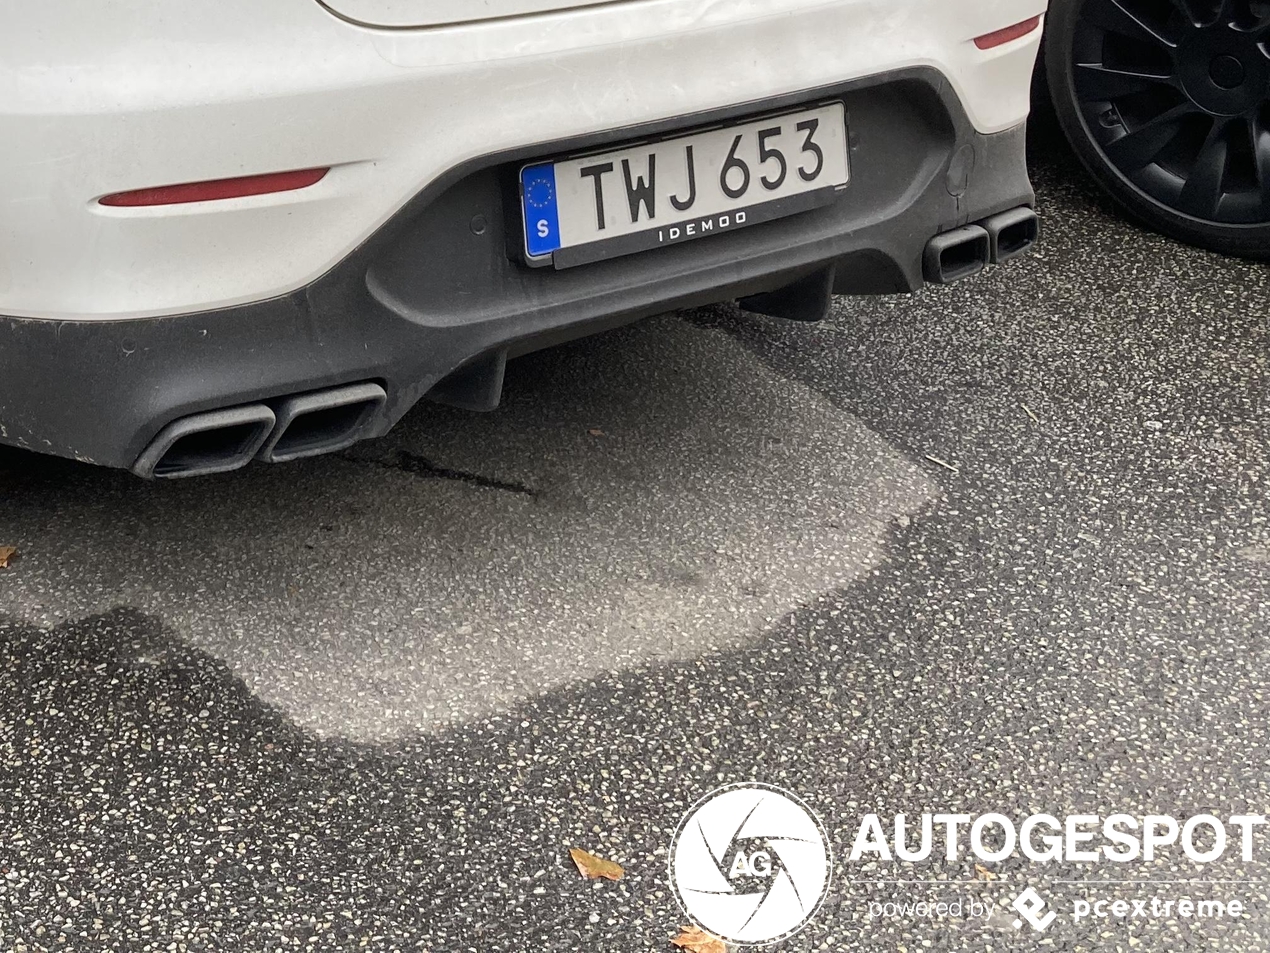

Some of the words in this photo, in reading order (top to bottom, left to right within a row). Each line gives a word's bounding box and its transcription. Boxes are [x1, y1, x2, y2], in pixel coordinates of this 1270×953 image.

[580, 144, 697, 230] TWJ
[720, 118, 824, 199] 653
[536, 219, 550, 238] S
[658, 211, 747, 242] IDEMOO
